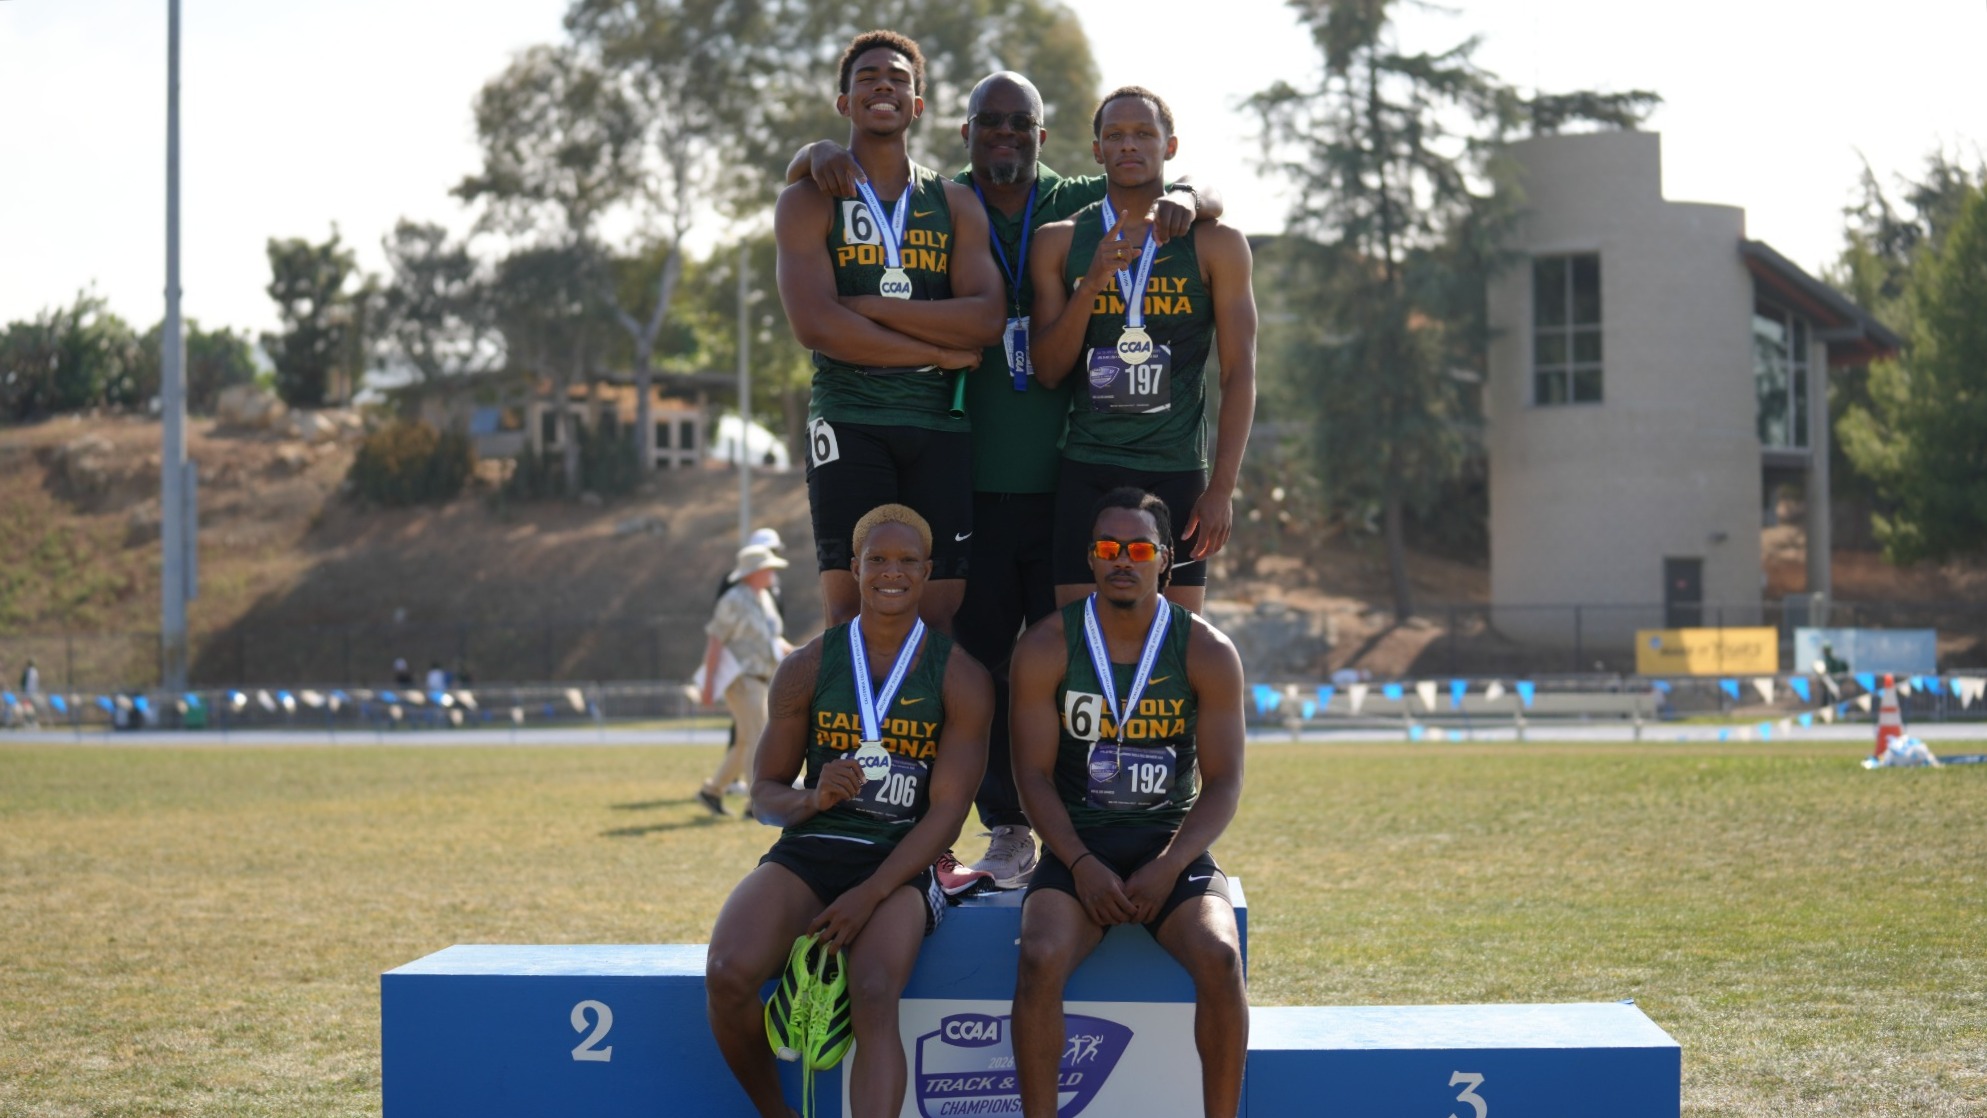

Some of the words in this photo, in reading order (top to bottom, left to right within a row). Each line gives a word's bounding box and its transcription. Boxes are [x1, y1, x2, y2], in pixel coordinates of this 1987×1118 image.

[852, 203, 872, 242] 6
[881, 282, 910, 294] CCAA
[1146, 277, 1188, 293] OLY
[1119, 341, 1151, 354] CCAA
[1015, 350, 1024, 372] CCAA
[1125, 364, 1163, 395] 197
[813, 418, 831, 462] 6
[1071, 695, 1093, 737] 6
[1121, 699, 1184, 716] OLY
[818, 711, 862, 731] CAL
[1061, 713, 1184, 738] MONA
[858, 755, 889, 768] CCAA
[1127, 763, 1168, 794] 192
[875, 772, 917, 808] 206
[570, 999, 614, 1062] 2
[945, 1021, 998, 1040] CCAA
[925, 1076, 997, 1093] TRACK
[998, 1077, 1015, 1089] &
[1448, 1070, 1488, 1118] 3
[940, 1098, 1023, 1116] CHAMPIONS
